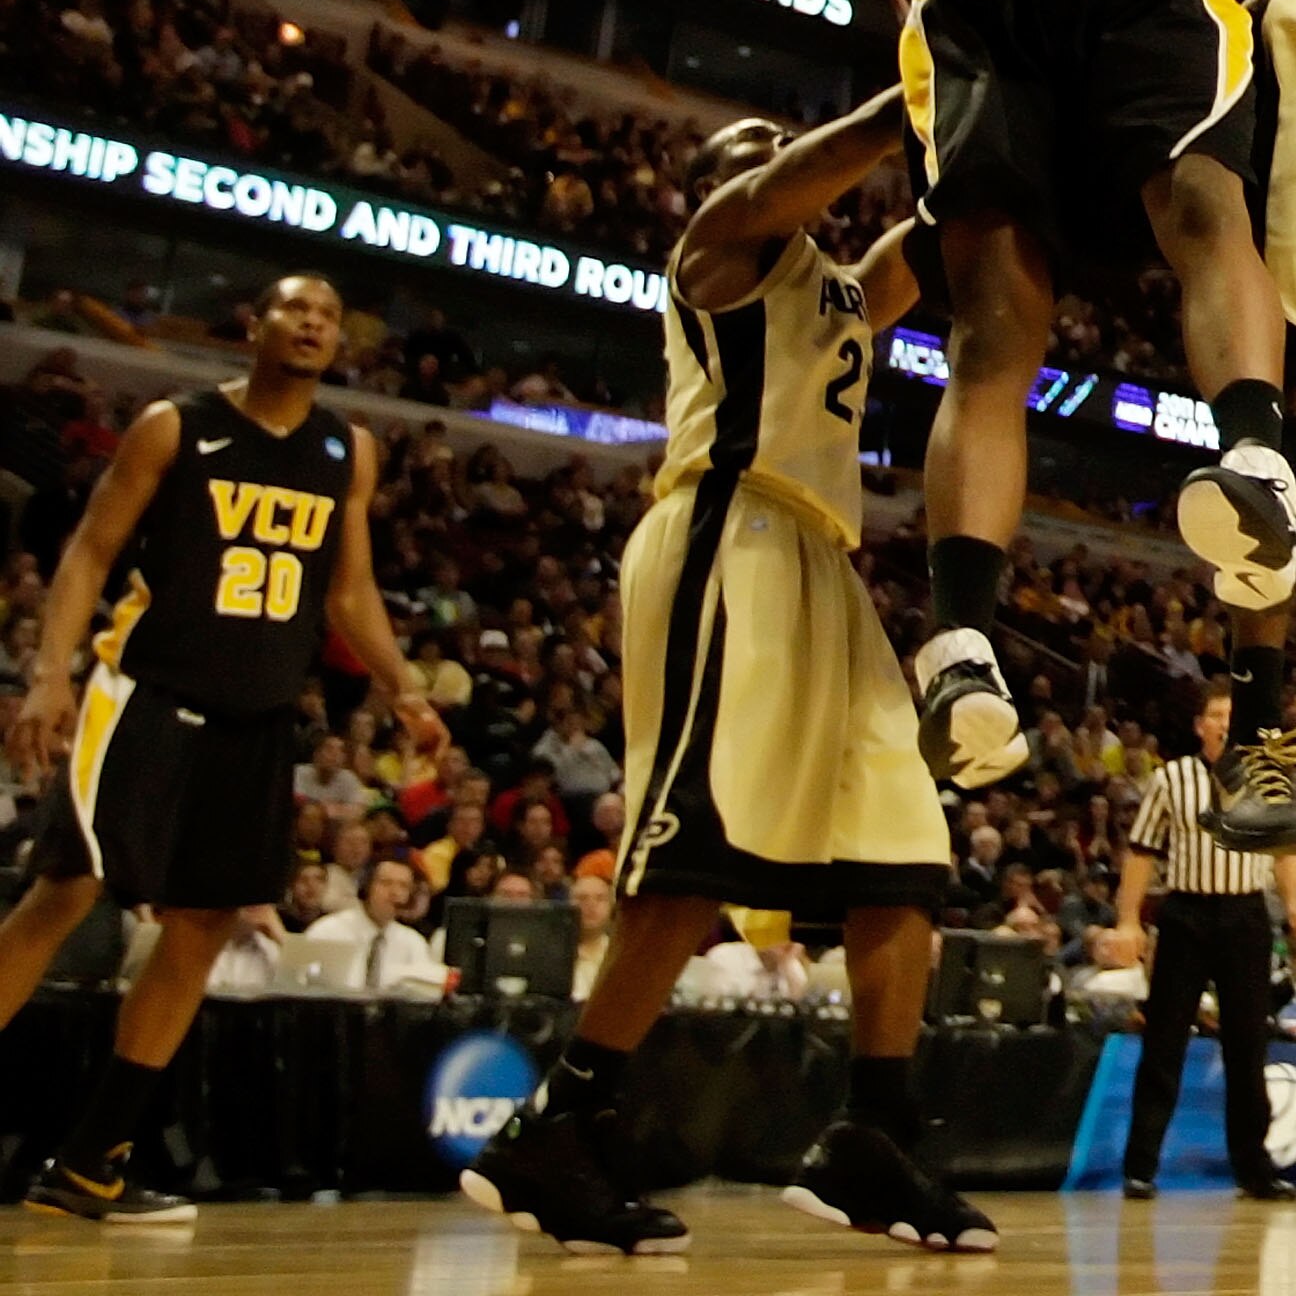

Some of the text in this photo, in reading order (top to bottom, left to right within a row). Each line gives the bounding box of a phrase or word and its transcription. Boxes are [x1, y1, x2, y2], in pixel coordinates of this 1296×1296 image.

[143, 151, 337, 232] SECOND
[341, 201, 440, 257] AND
[448, 224, 570, 288] THIRD
[208, 478, 336, 552] VCU
[215, 546, 303, 622] 20
